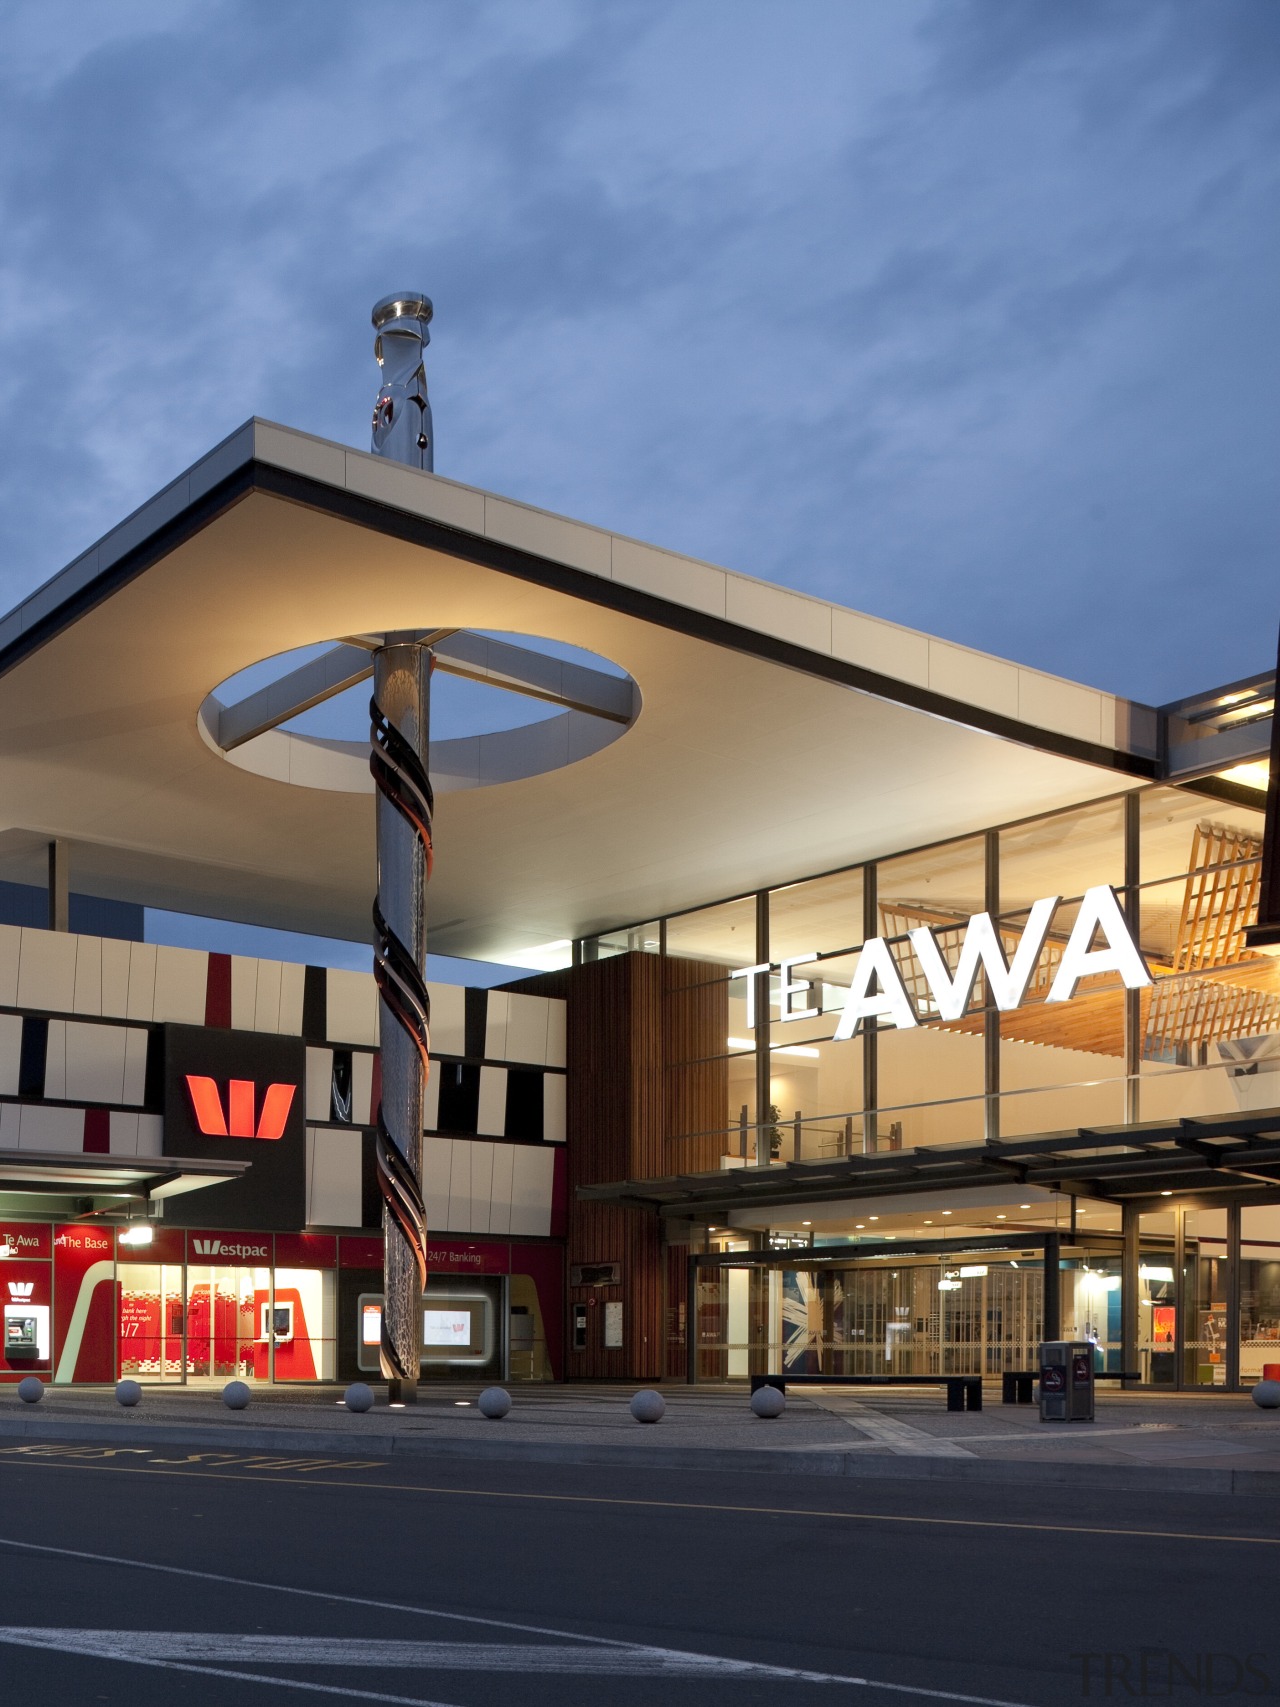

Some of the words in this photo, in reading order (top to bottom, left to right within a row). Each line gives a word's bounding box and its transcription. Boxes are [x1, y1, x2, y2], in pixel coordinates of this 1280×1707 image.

[731, 950, 822, 1029] TE
[832, 884, 1157, 1042] AWA
[2, 1234, 15, 1246] Te
[16, 1234, 40, 1247] Awa
[63, 1235, 81, 1248] The
[85, 1237, 109, 1249] Base
[193, 1239, 268, 1259] Westpac
[428, 1250, 447, 1263] 24/7
[449, 1251, 481, 1265] Banking
[148, 1453, 391, 1472] STOP
